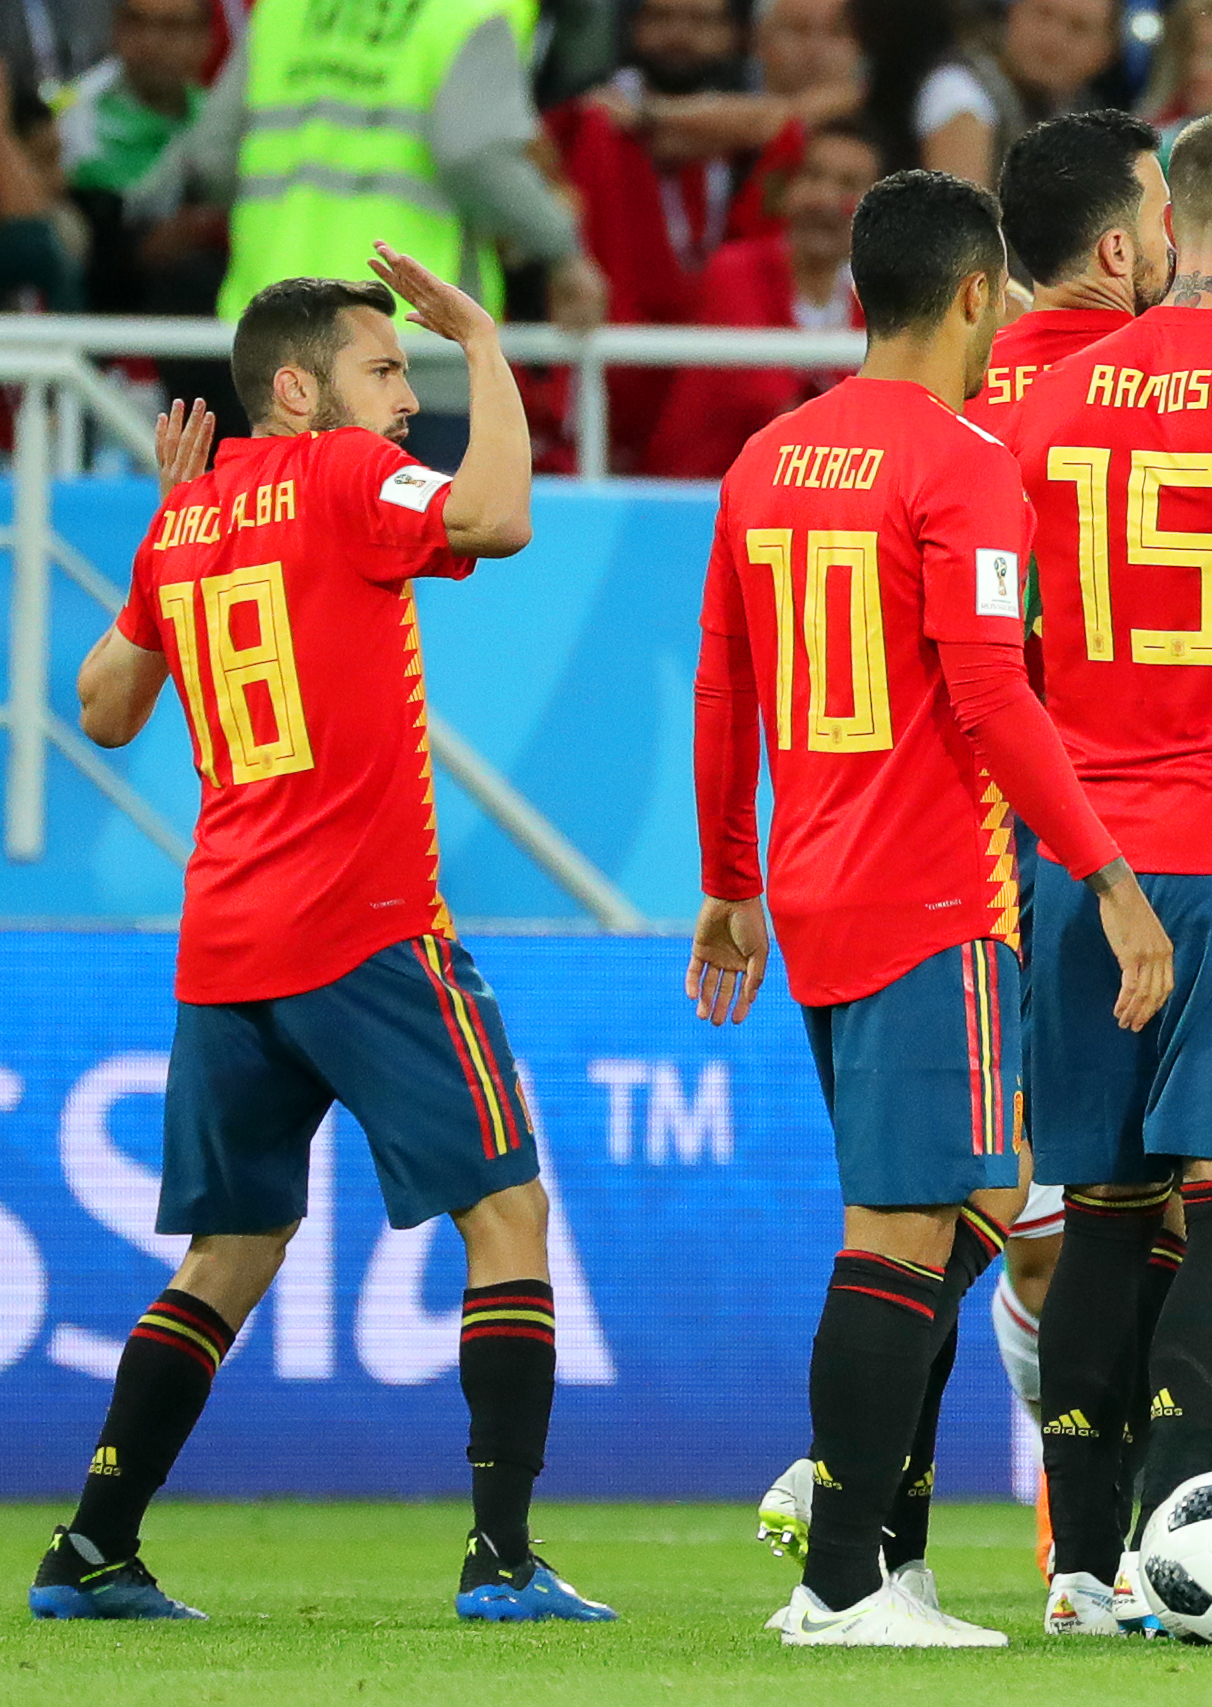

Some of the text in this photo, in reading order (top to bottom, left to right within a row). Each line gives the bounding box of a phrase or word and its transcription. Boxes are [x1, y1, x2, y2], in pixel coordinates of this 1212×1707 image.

[1086, 364, 1212, 414] RAMOS
[773, 445, 885, 489] THIAGO
[158, 560, 315, 788] 18
[746, 528, 894, 754] 10
[588, 1059, 735, 1165] TM
[1043, 1424, 1100, 1438] adidas
